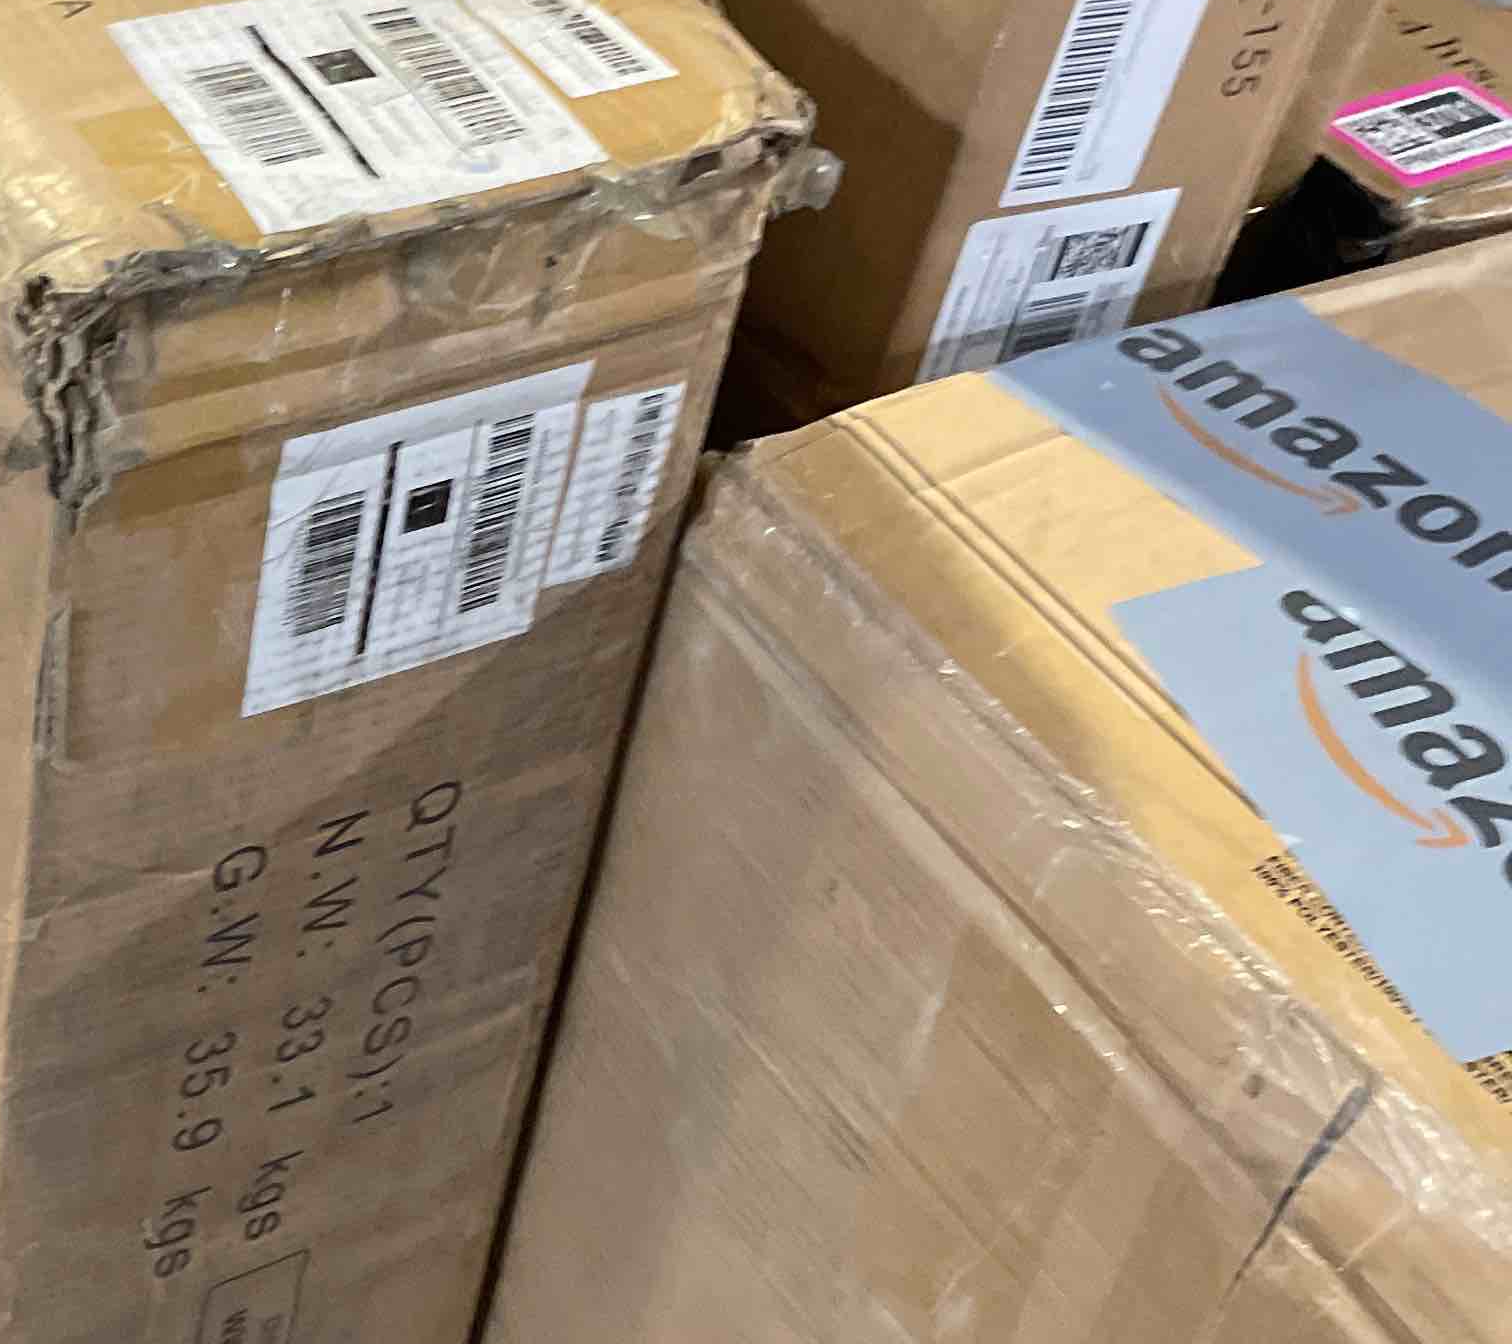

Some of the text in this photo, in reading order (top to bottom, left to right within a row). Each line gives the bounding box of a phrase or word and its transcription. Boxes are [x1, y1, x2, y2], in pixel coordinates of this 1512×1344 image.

[174, 1031, 237, 1153] 35.9
[269, 996, 333, 1113] 33.1
[144, 1187, 212, 1280] kgs
[236, 1149, 304, 1242] kgs
